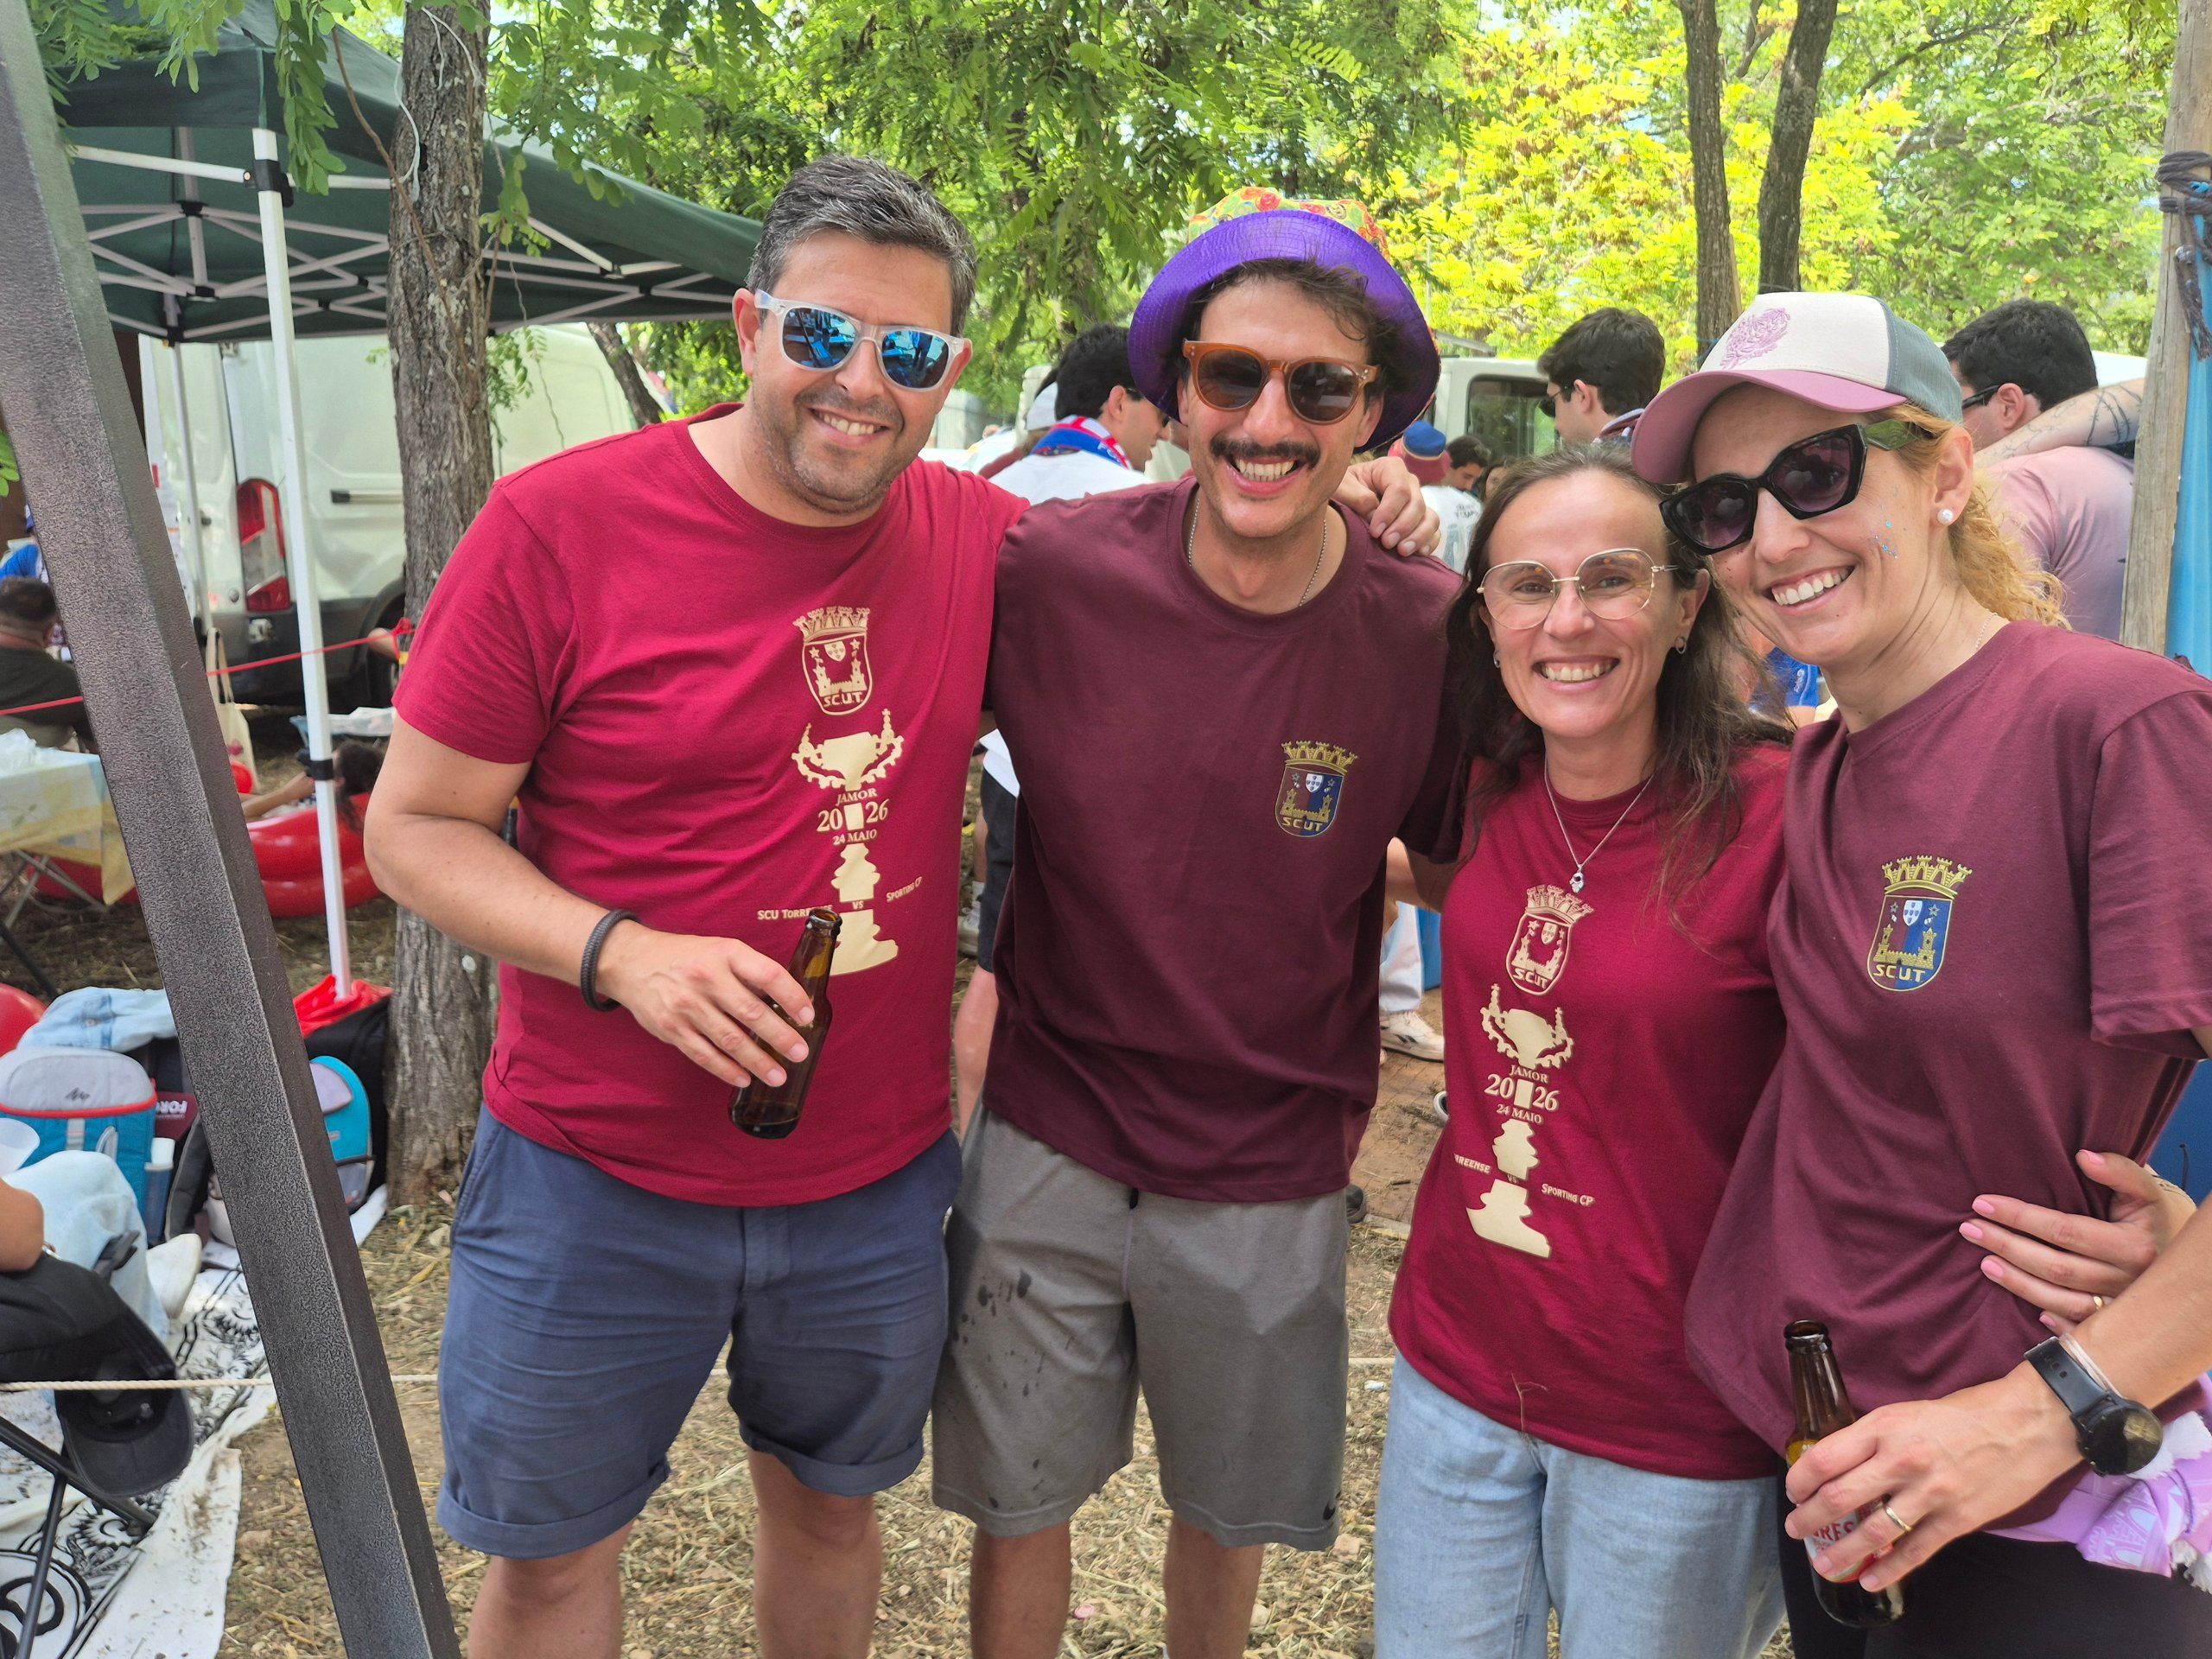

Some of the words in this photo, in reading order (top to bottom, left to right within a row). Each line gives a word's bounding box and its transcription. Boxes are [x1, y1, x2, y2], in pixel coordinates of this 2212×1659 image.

[835, 788, 878, 806] JAMOR
[817, 808, 843, 832] 20
[865, 798, 890, 823] 26
[833, 834, 846, 846] 24
[848, 829, 877, 842] MAIO
[758, 910, 779, 920] SCU
[1510, 1065, 1549, 1084] JAMOR
[1484, 1073, 1514, 1098] 20
[1533, 1086, 1560, 1111] 26
[1497, 1103, 1510, 1116] 24
[1512, 1108, 1542, 1124] MAIO
[1541, 1183, 1578, 1203] SPORTING
[1580, 1194, 1594, 1207] CP
